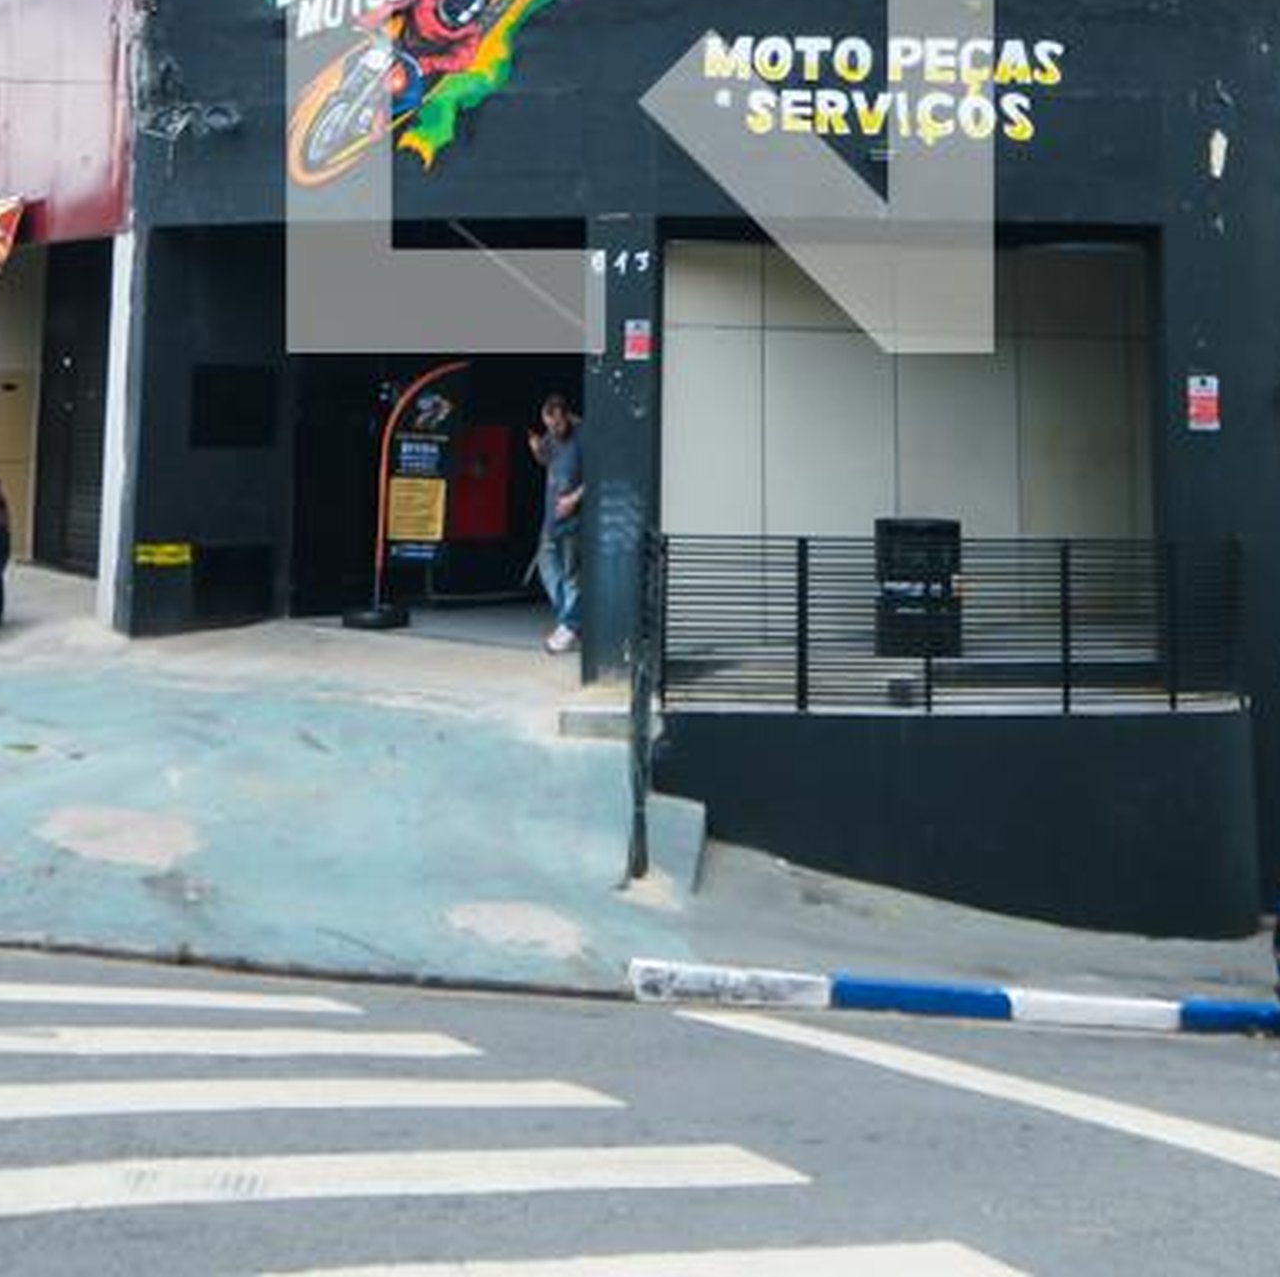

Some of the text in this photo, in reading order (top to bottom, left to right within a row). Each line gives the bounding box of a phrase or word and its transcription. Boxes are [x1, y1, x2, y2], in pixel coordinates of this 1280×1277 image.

[704, 36, 1064, 96] MOTO PEÇAS
[746, 89, 1035, 146] SERVIÇOS
